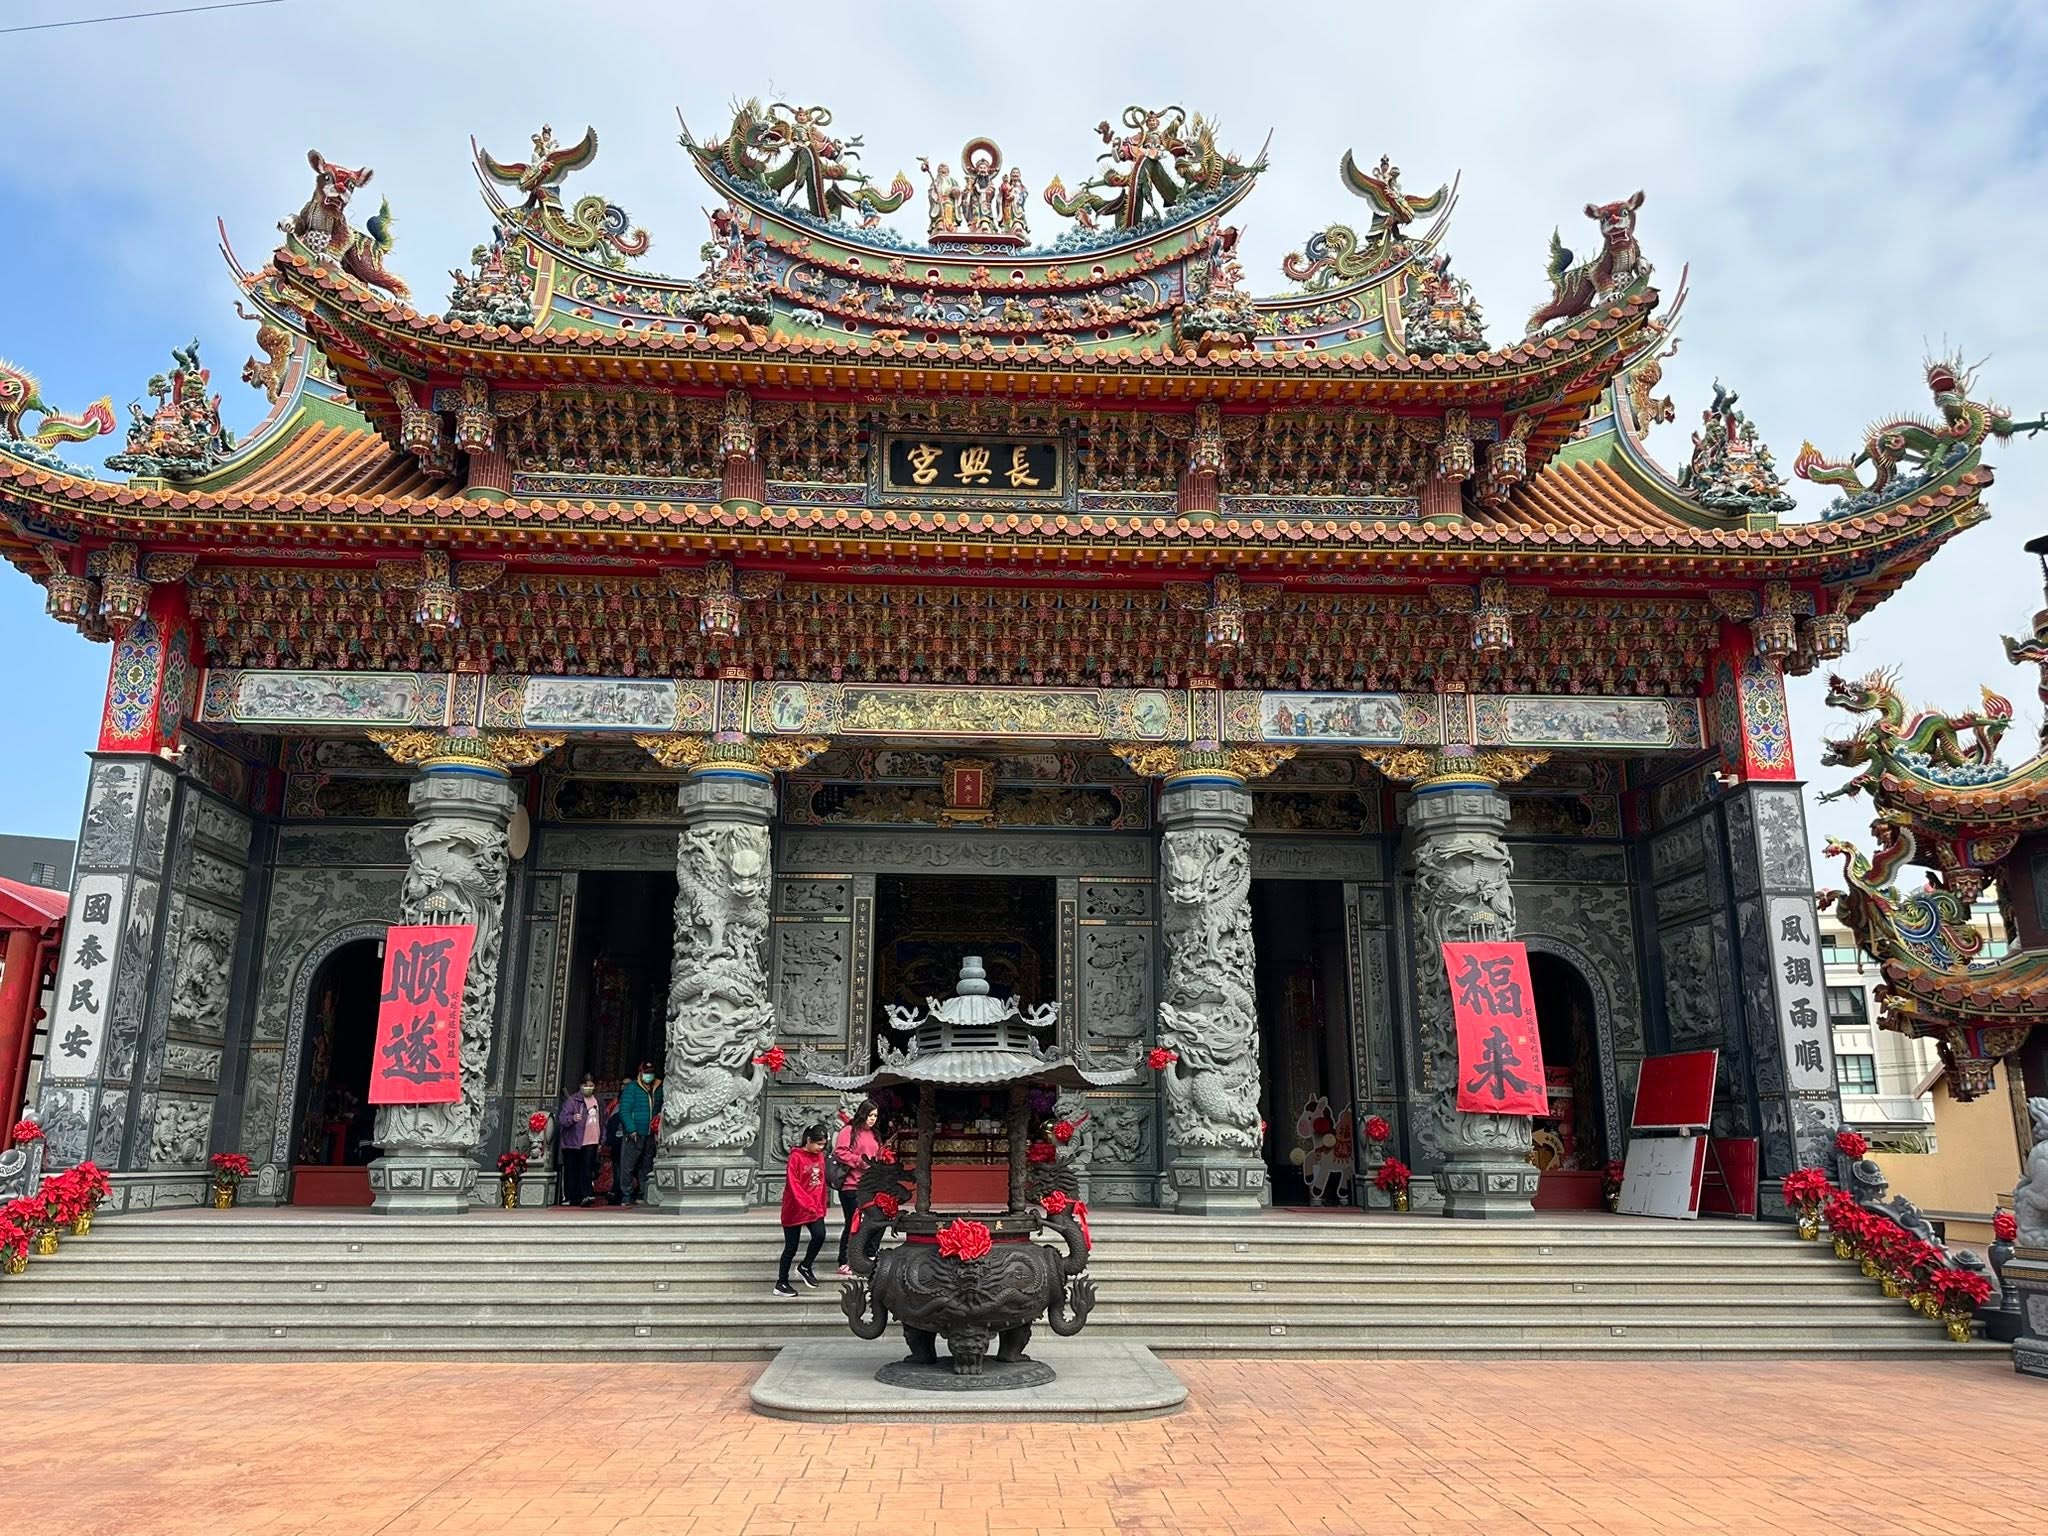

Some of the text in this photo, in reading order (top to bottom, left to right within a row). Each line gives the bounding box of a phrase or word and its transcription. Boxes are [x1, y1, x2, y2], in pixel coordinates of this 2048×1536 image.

[59, 893, 112, 1059] 國泰民安
[1781, 915, 1824, 1072] 風調雨順
